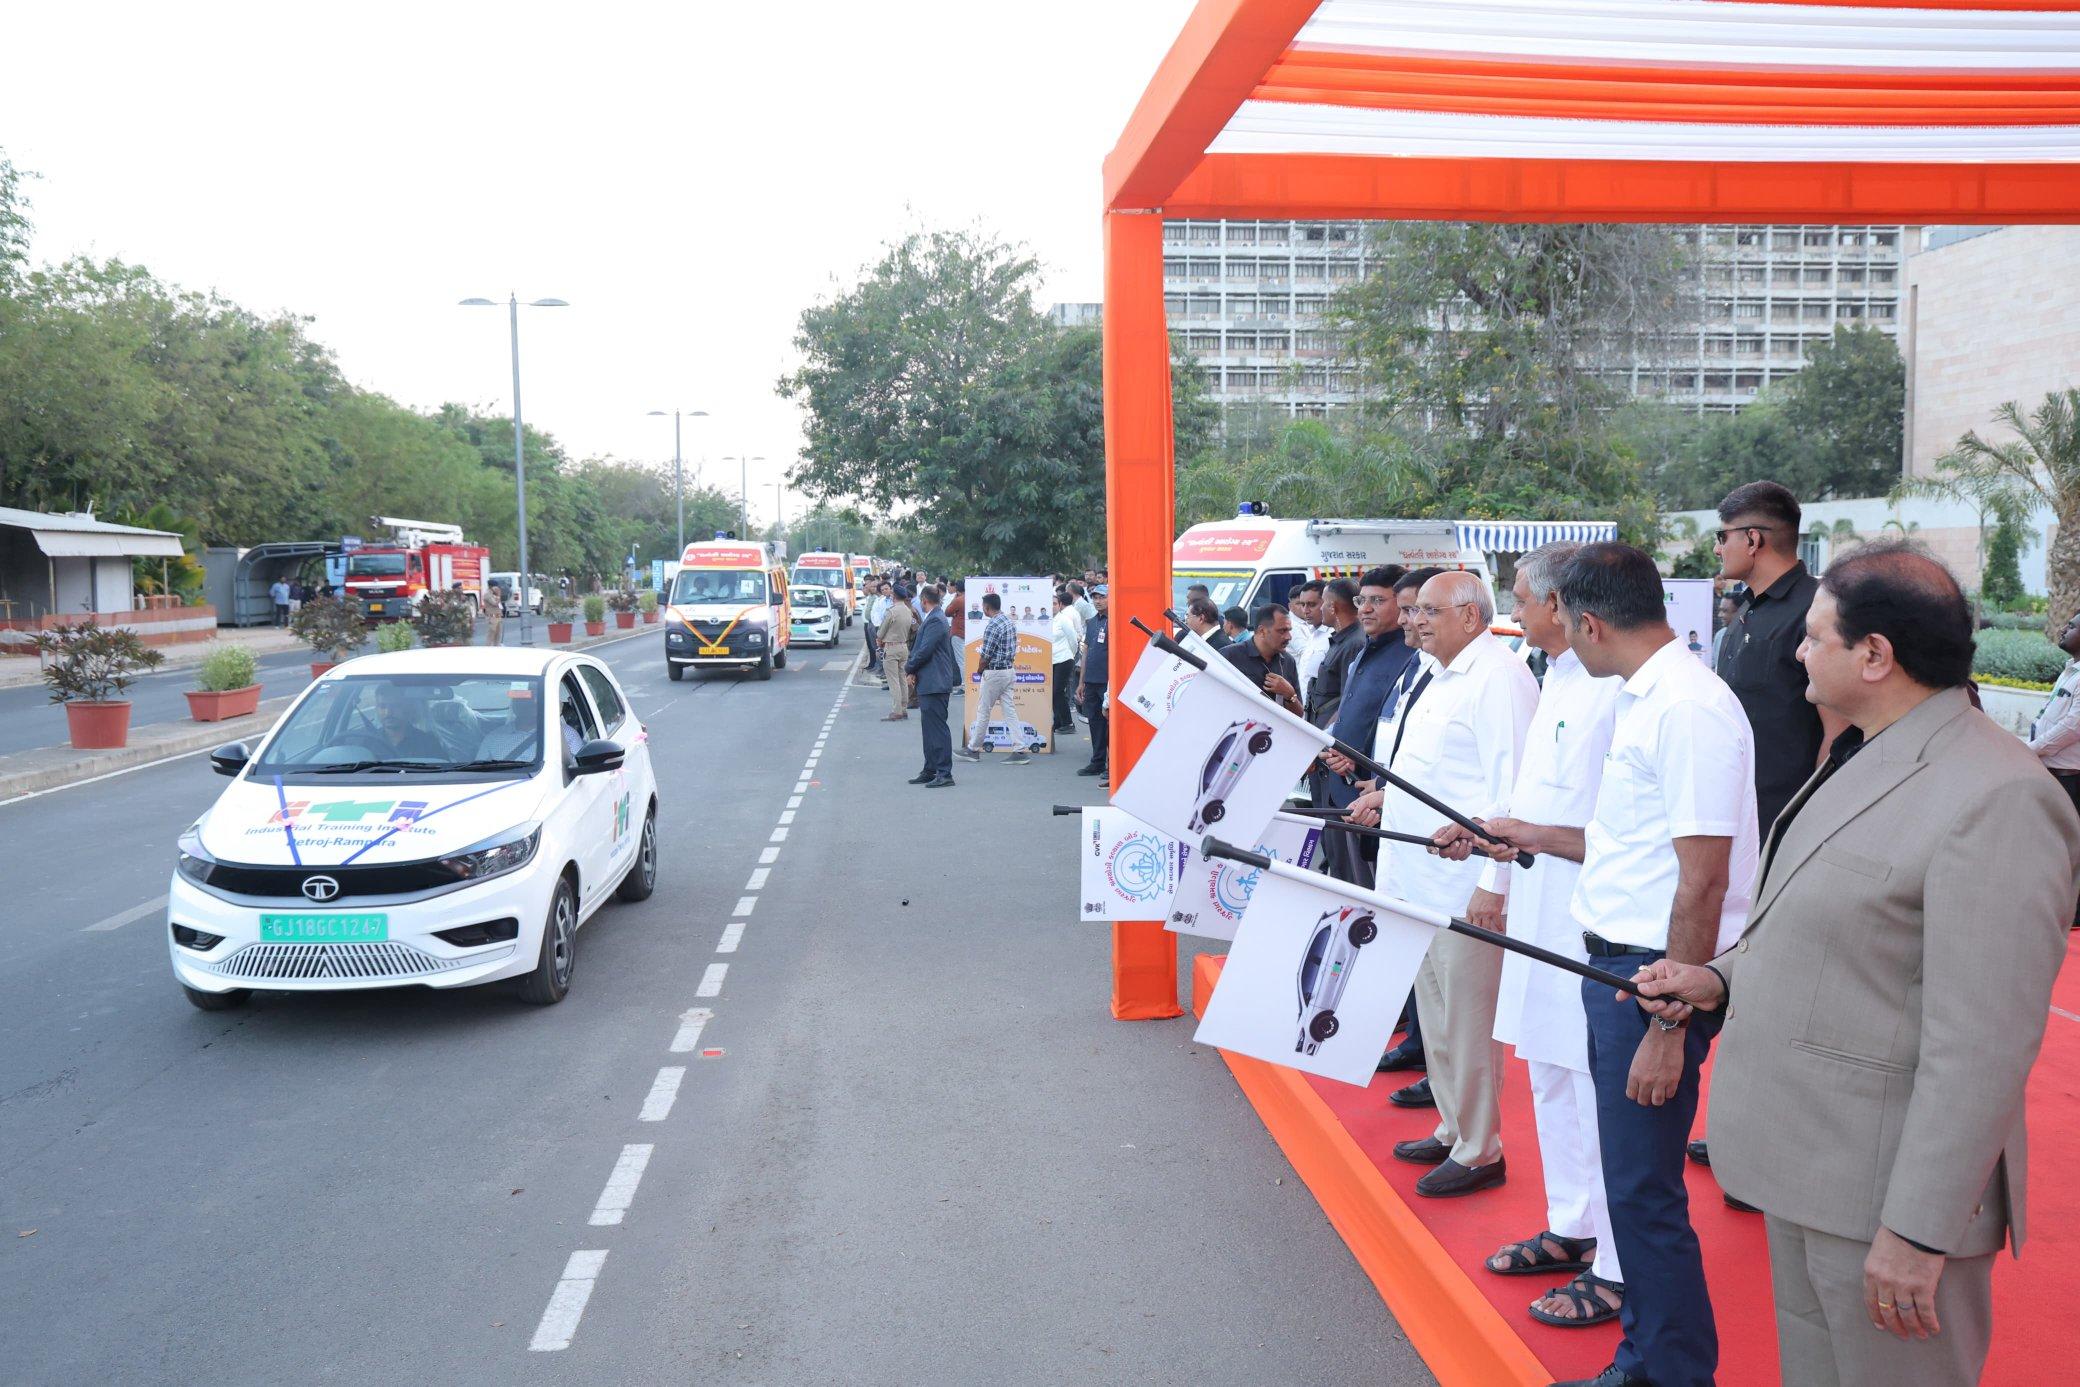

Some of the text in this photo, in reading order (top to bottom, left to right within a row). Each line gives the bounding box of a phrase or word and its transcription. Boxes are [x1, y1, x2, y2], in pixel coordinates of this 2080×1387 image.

[1320, 551, 1367, 562] ગુજરાત સરકાર
[317, 823, 373, 833] Training
[1303, 840, 1315, 858] વિભાગ
[1115, 888, 1137, 904] ગુજરાત
[1213, 901, 1233, 921] ગુજરાત
[273, 918, 383, 937] GJ18GC1247
